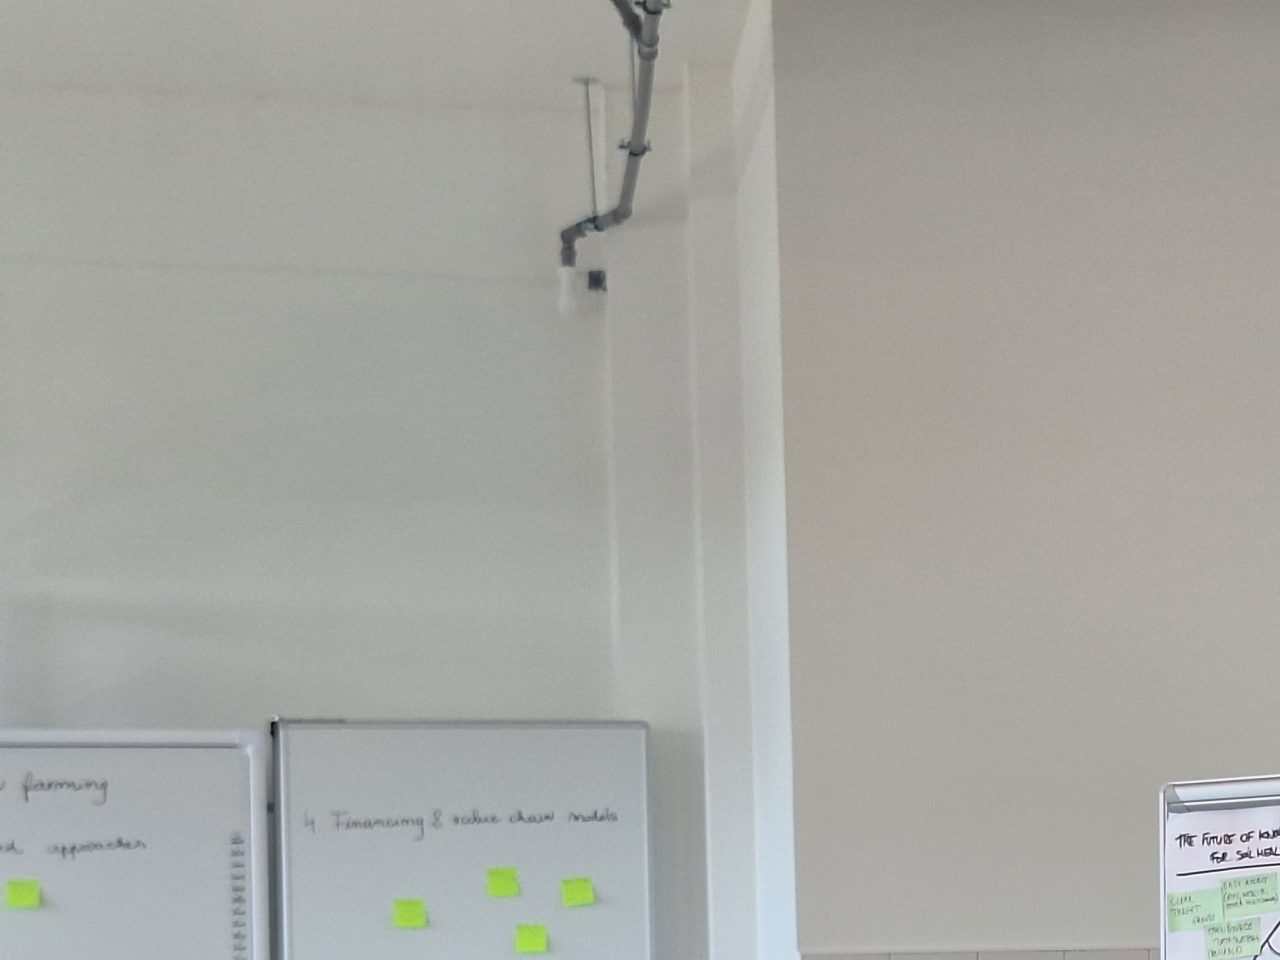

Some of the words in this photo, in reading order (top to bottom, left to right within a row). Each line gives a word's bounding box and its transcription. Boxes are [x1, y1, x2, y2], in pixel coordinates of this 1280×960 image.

[1175, 833, 1197, 849] THE
[1202, 832, 1236, 846] FUTURE
[1240, 831, 1255, 843] OF
[1210, 851, 1229, 864] FOR
